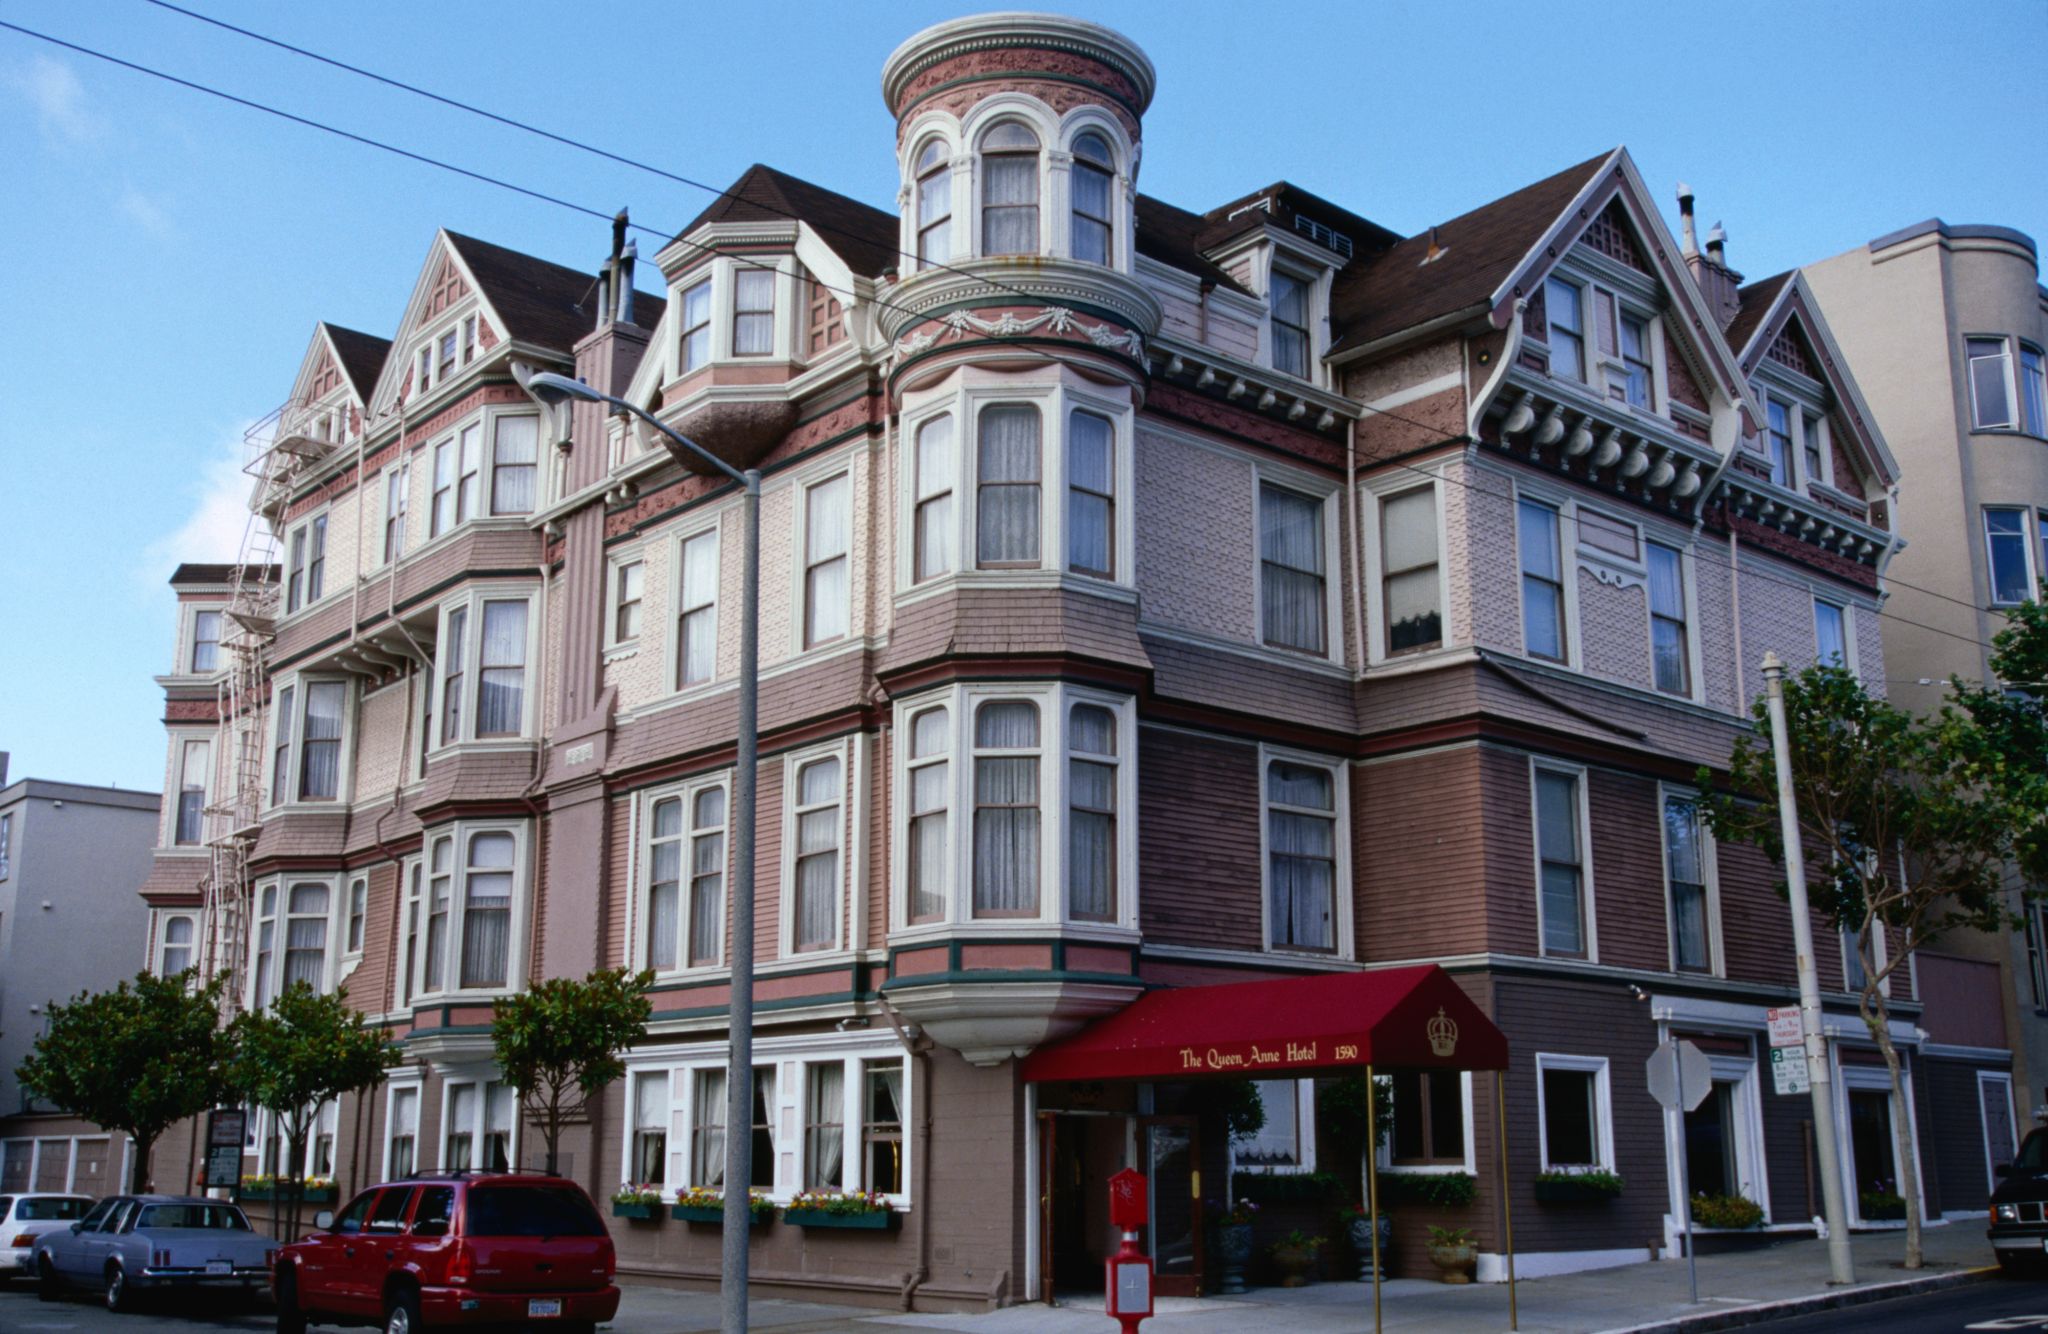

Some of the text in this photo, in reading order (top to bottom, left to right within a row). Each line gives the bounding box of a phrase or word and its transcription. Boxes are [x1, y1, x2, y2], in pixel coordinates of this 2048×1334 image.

[1180, 1041, 1358, 1069] The Queen Anne Hotel 1590
[1774, 1051, 1782, 1061] 2
